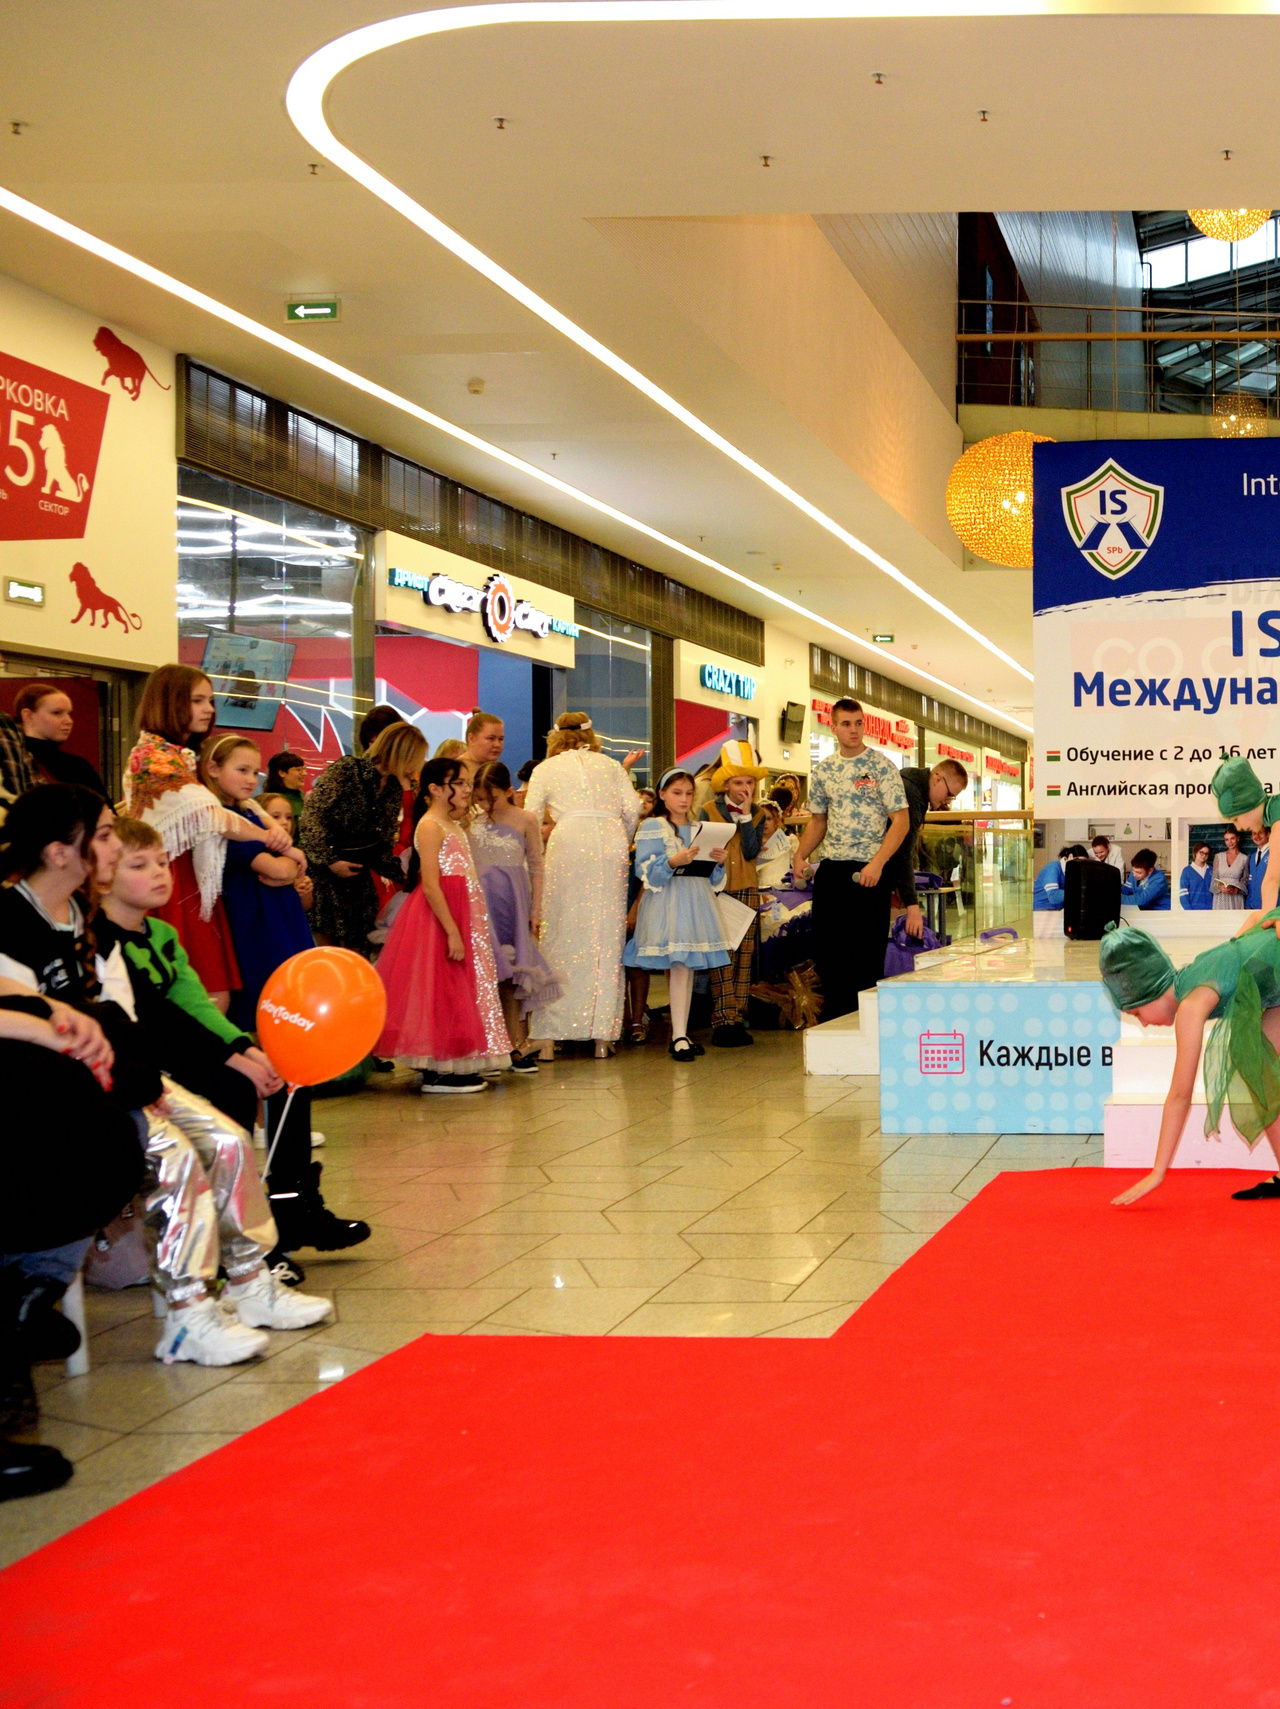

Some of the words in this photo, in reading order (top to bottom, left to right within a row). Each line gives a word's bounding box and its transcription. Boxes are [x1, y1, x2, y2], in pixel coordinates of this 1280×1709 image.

[4, 409, 35, 487] 5
[38, 499, 70, 517] СЕКТОР
[1099, 489, 1128, 516] IS
[1106, 546, 1123, 554] SPb
[704, 663, 738, 695] CRAZY
[1066, 746, 1154, 765] Обучение
[1159, 749, 1168, 761] с
[1173, 745, 1184, 761] 2
[1189, 748, 1212, 763] до
[1247, 746, 1278, 760] лет
[1066, 780, 1169, 797] Английская
[979, 1039, 1091, 1071] Каждые
